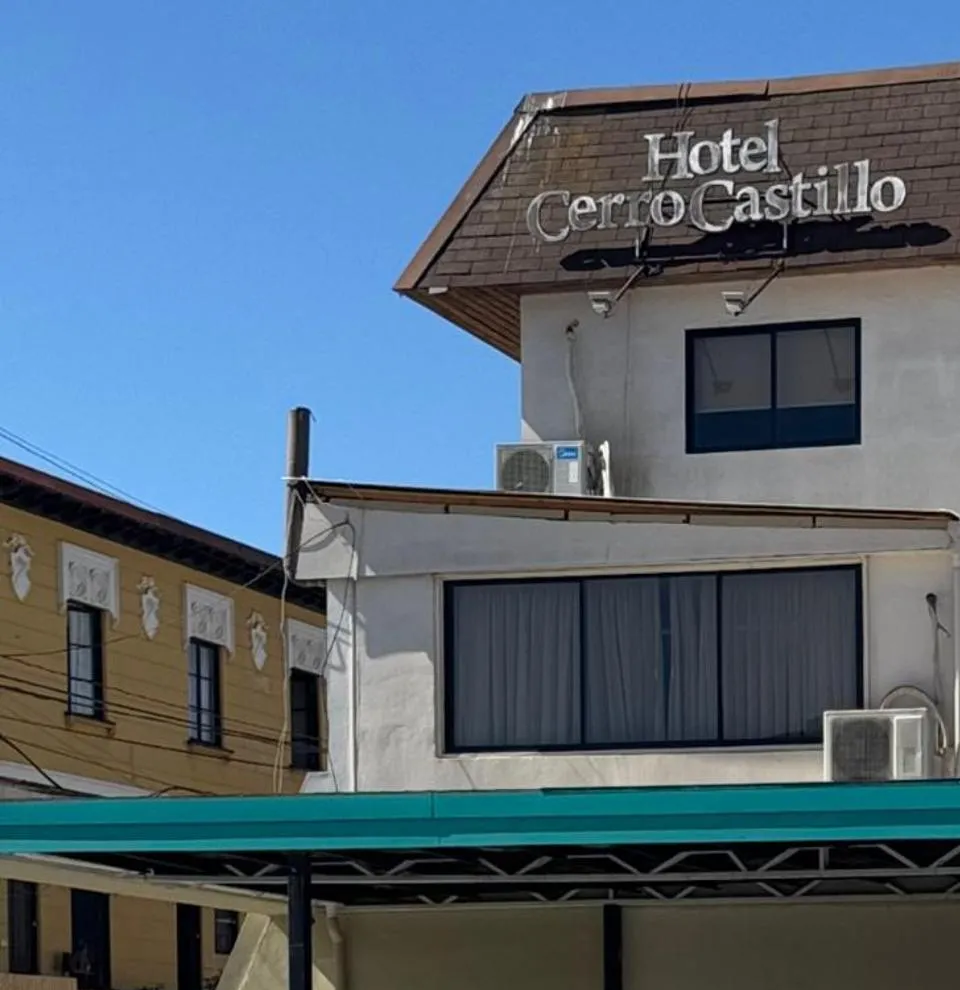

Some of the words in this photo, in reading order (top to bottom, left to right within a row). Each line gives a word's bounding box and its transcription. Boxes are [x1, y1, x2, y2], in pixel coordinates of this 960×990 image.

[642, 119, 781, 181] Hotel
[526, 189, 686, 242] Cerro
[688, 159, 907, 232] Castillo
